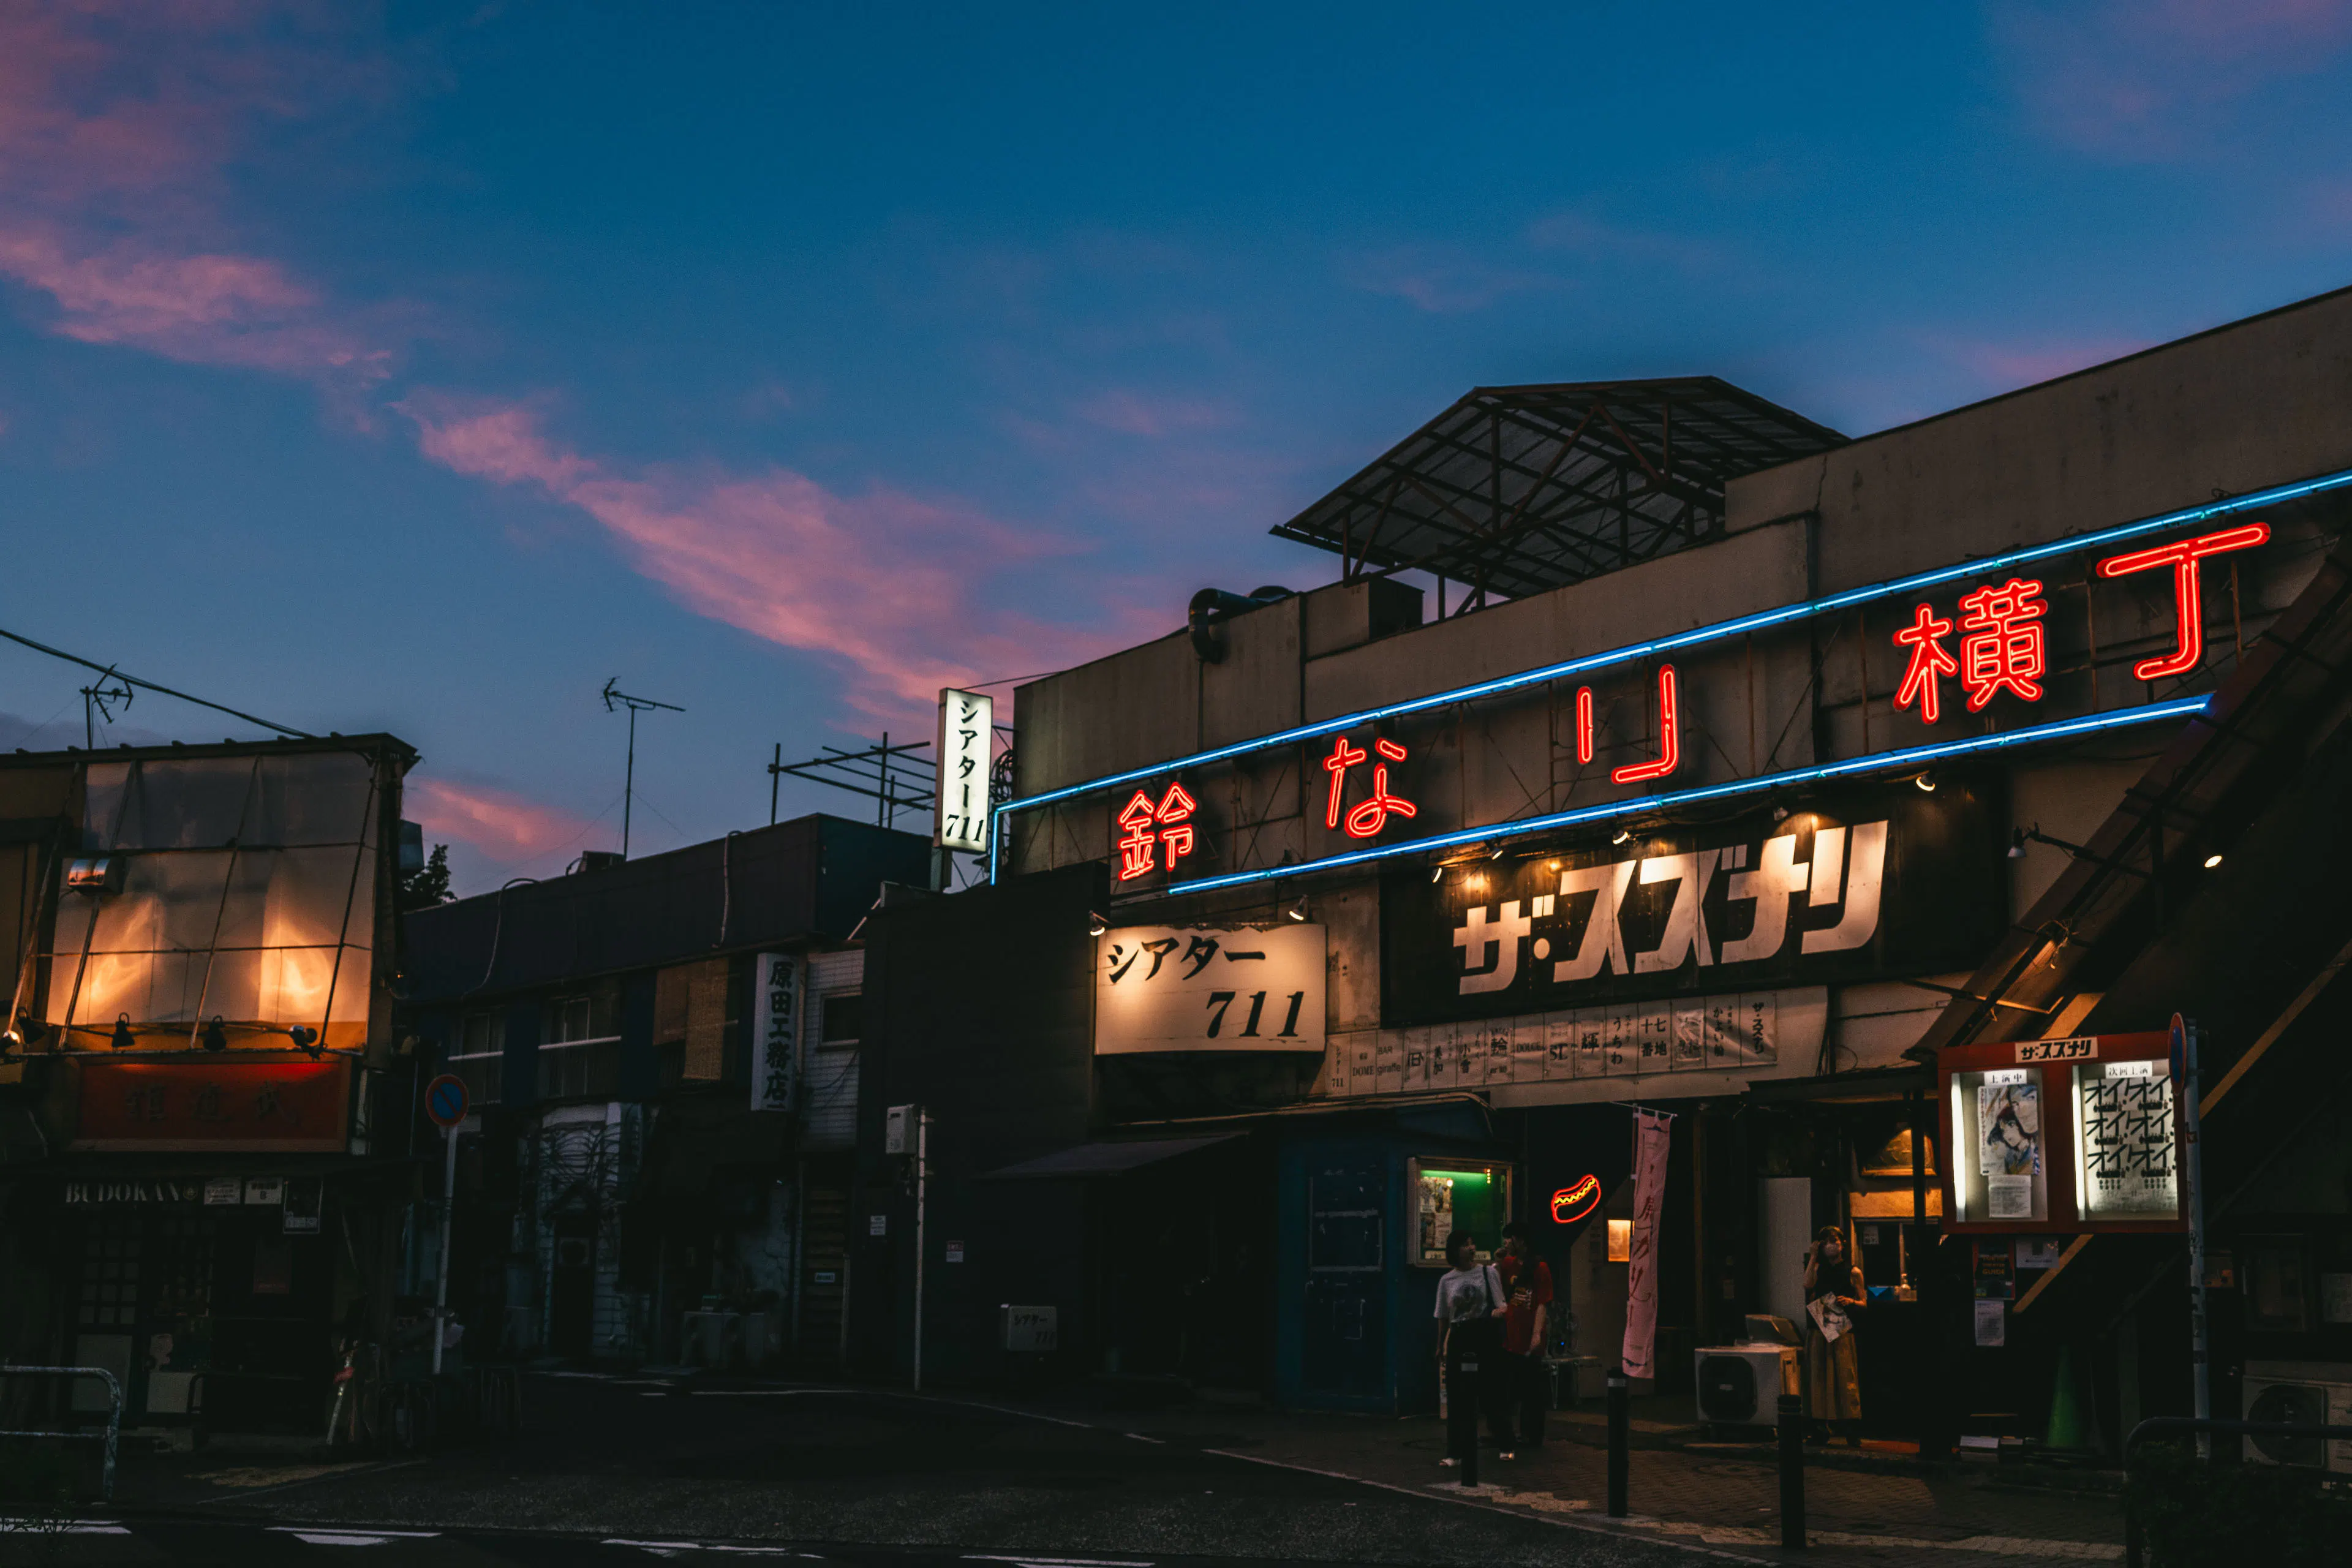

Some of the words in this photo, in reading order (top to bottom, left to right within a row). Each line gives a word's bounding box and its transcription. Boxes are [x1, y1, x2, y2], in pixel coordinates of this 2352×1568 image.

[959, 700, 978, 808] シアター
[946, 814, 984, 842] 711
[1453, 820, 1888, 995] ザ・スズナリ
[1107, 935, 1266, 984] シアター
[1206, 991, 1305, 1039] 711
[1611, 1016, 1623, 1065] うちわ
[2021, 1039, 2092, 1060] ザ・スズナリ
